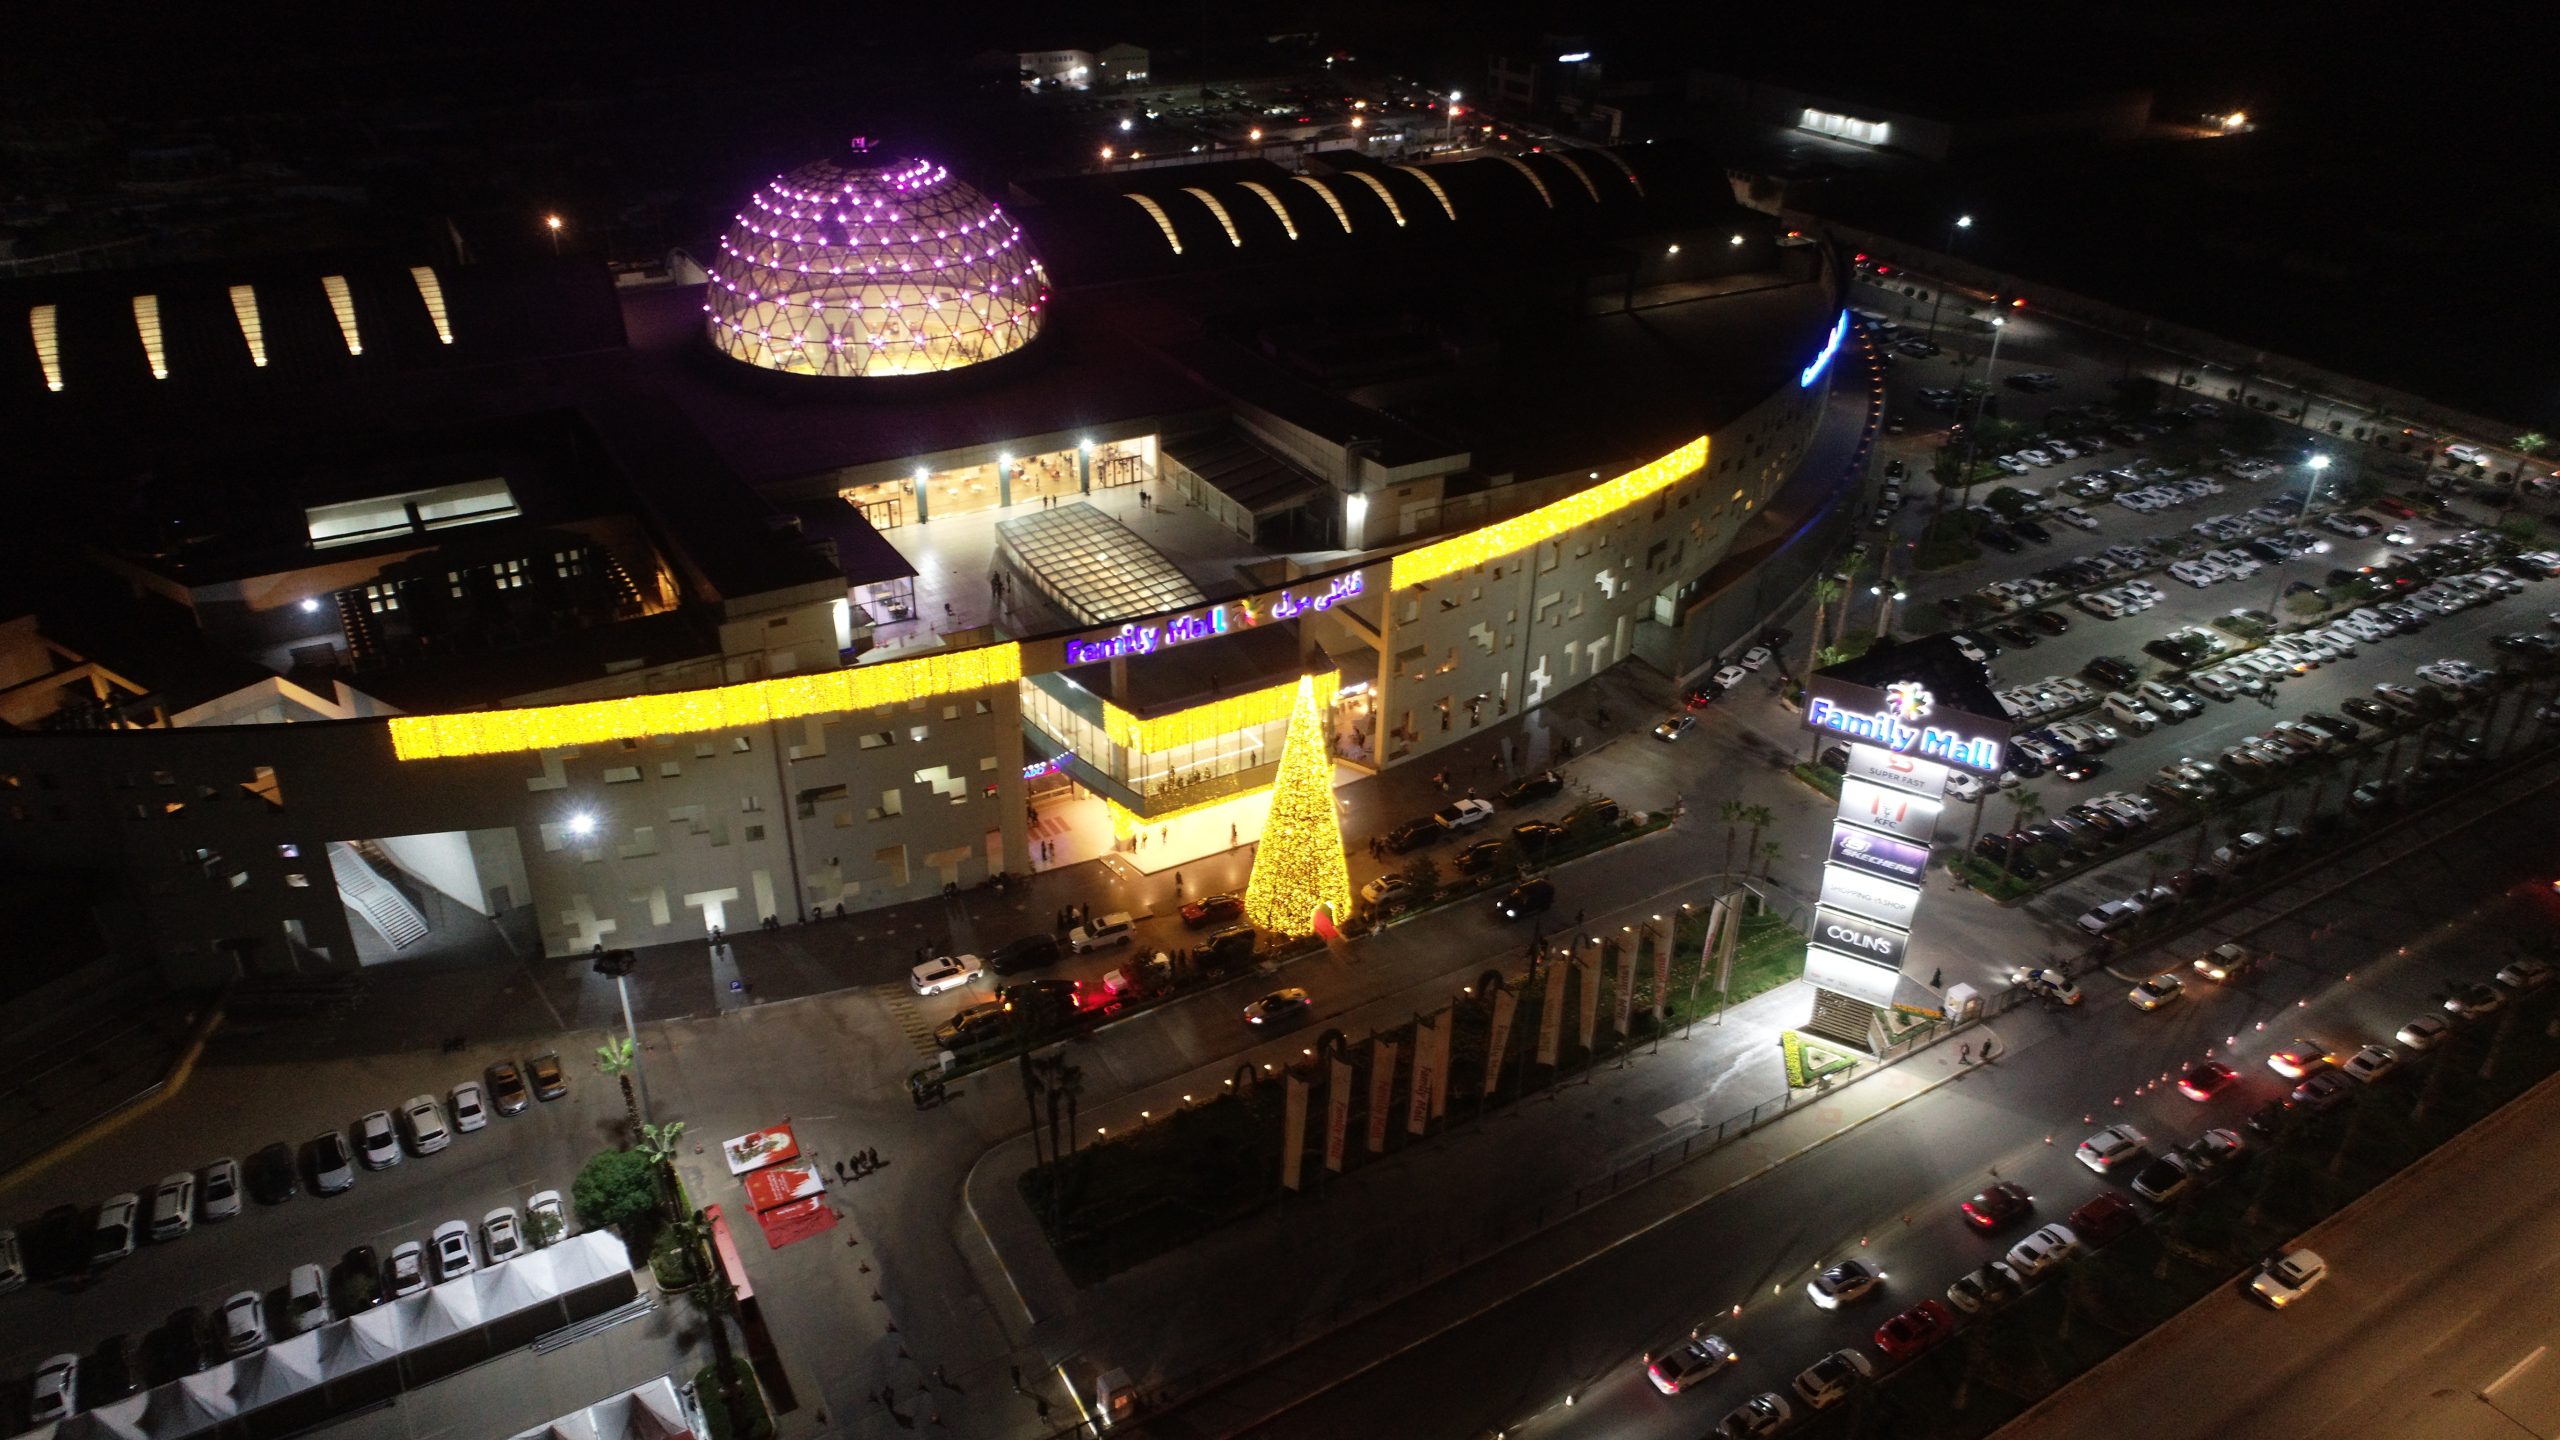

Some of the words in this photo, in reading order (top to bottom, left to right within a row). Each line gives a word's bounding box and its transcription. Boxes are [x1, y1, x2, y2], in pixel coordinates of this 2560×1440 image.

[1066, 624, 1160, 664] Family
[1166, 607, 1227, 645] Mall
[1810, 699, 1918, 752] Family
[1922, 729, 1997, 770] Mall
[1868, 767, 1899, 781] SUPER
[1901, 777, 1925, 788] FAST
[1873, 817, 1897, 828] KFC
[1841, 848, 1917, 875] SKECHERS
[1827, 925, 1892, 954] COLIN'S
[1416, 1065, 1432, 1098] Family
[1413, 1099, 1427, 1122] Mall
